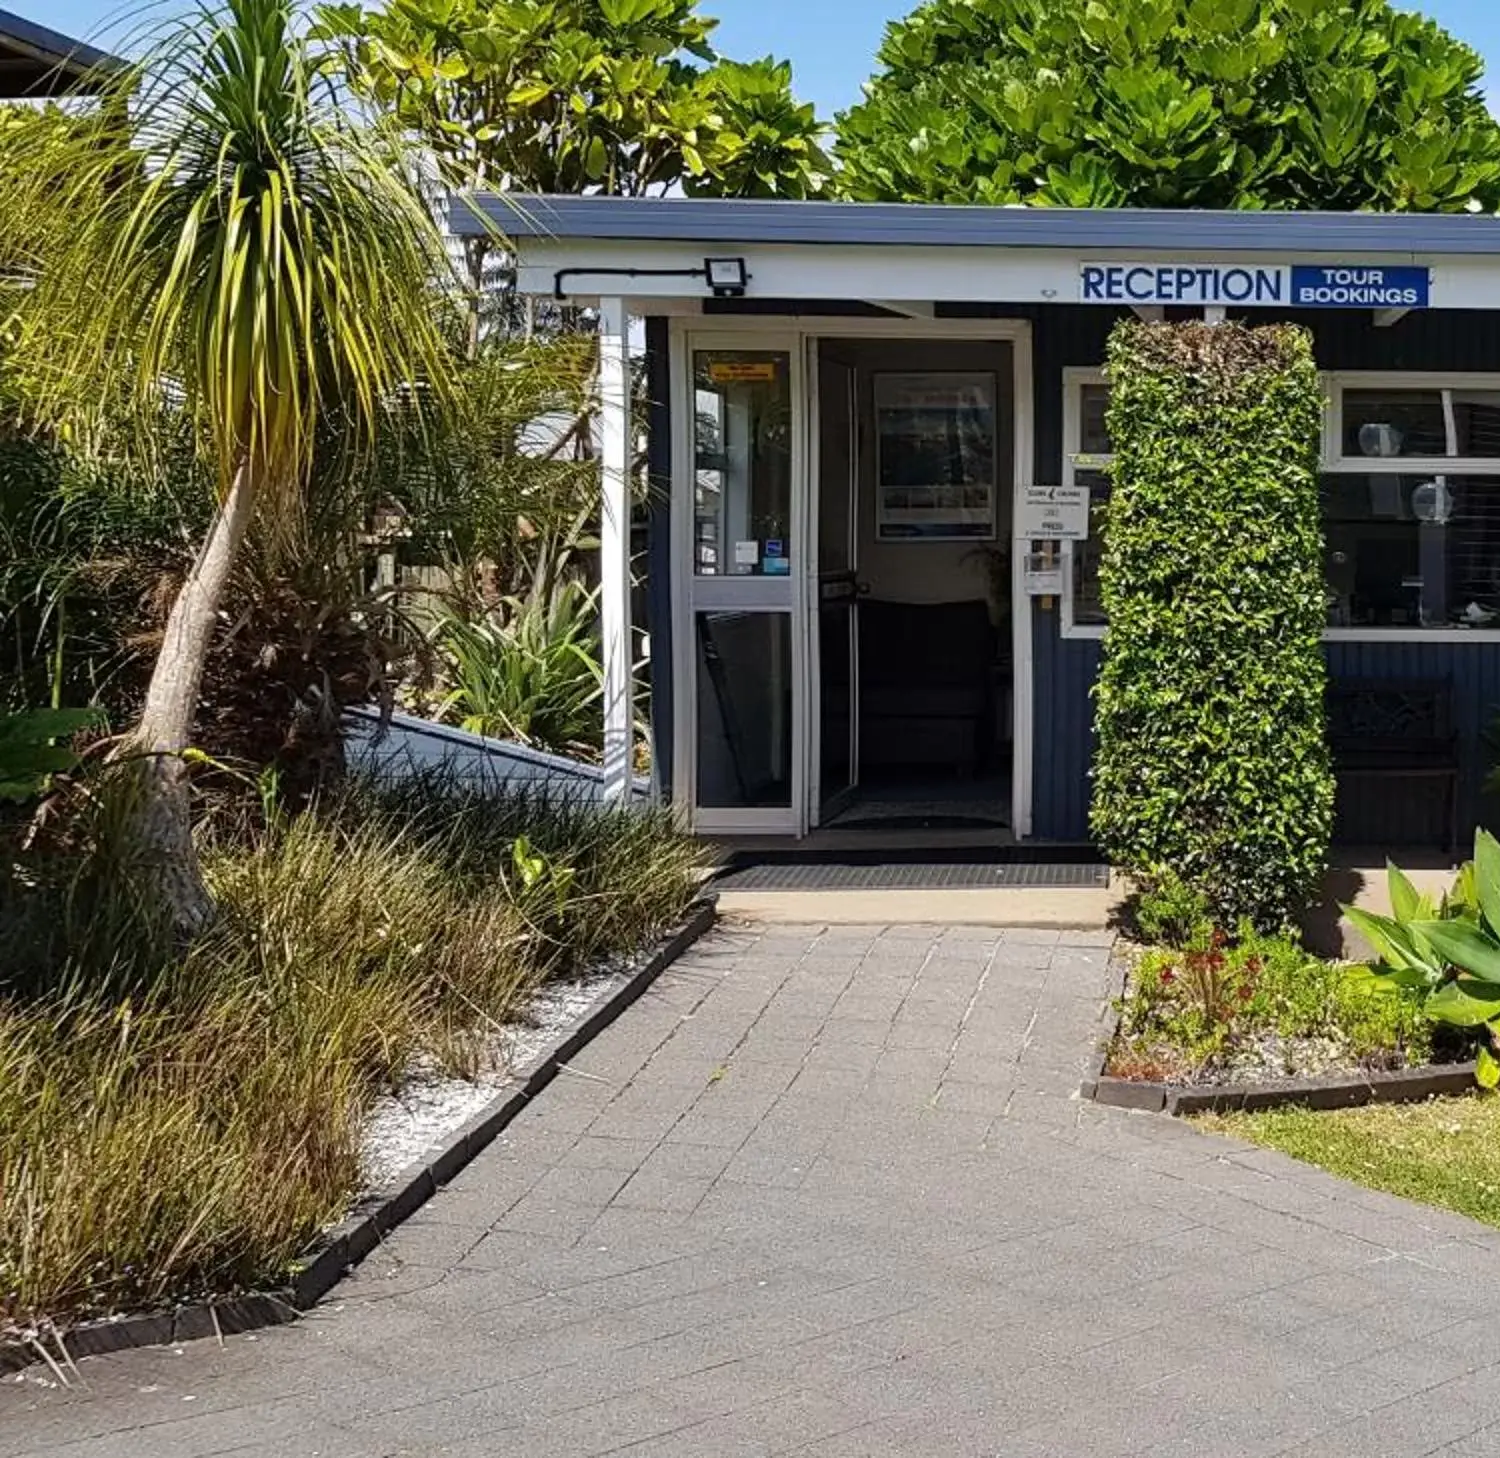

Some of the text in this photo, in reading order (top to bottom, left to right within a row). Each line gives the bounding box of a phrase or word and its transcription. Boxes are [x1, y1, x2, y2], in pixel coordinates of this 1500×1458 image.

[1083, 267, 1281, 301] RECEPTION
[1322, 269, 1383, 285] TOUR
[1300, 287, 1417, 303] BOOKINGS
